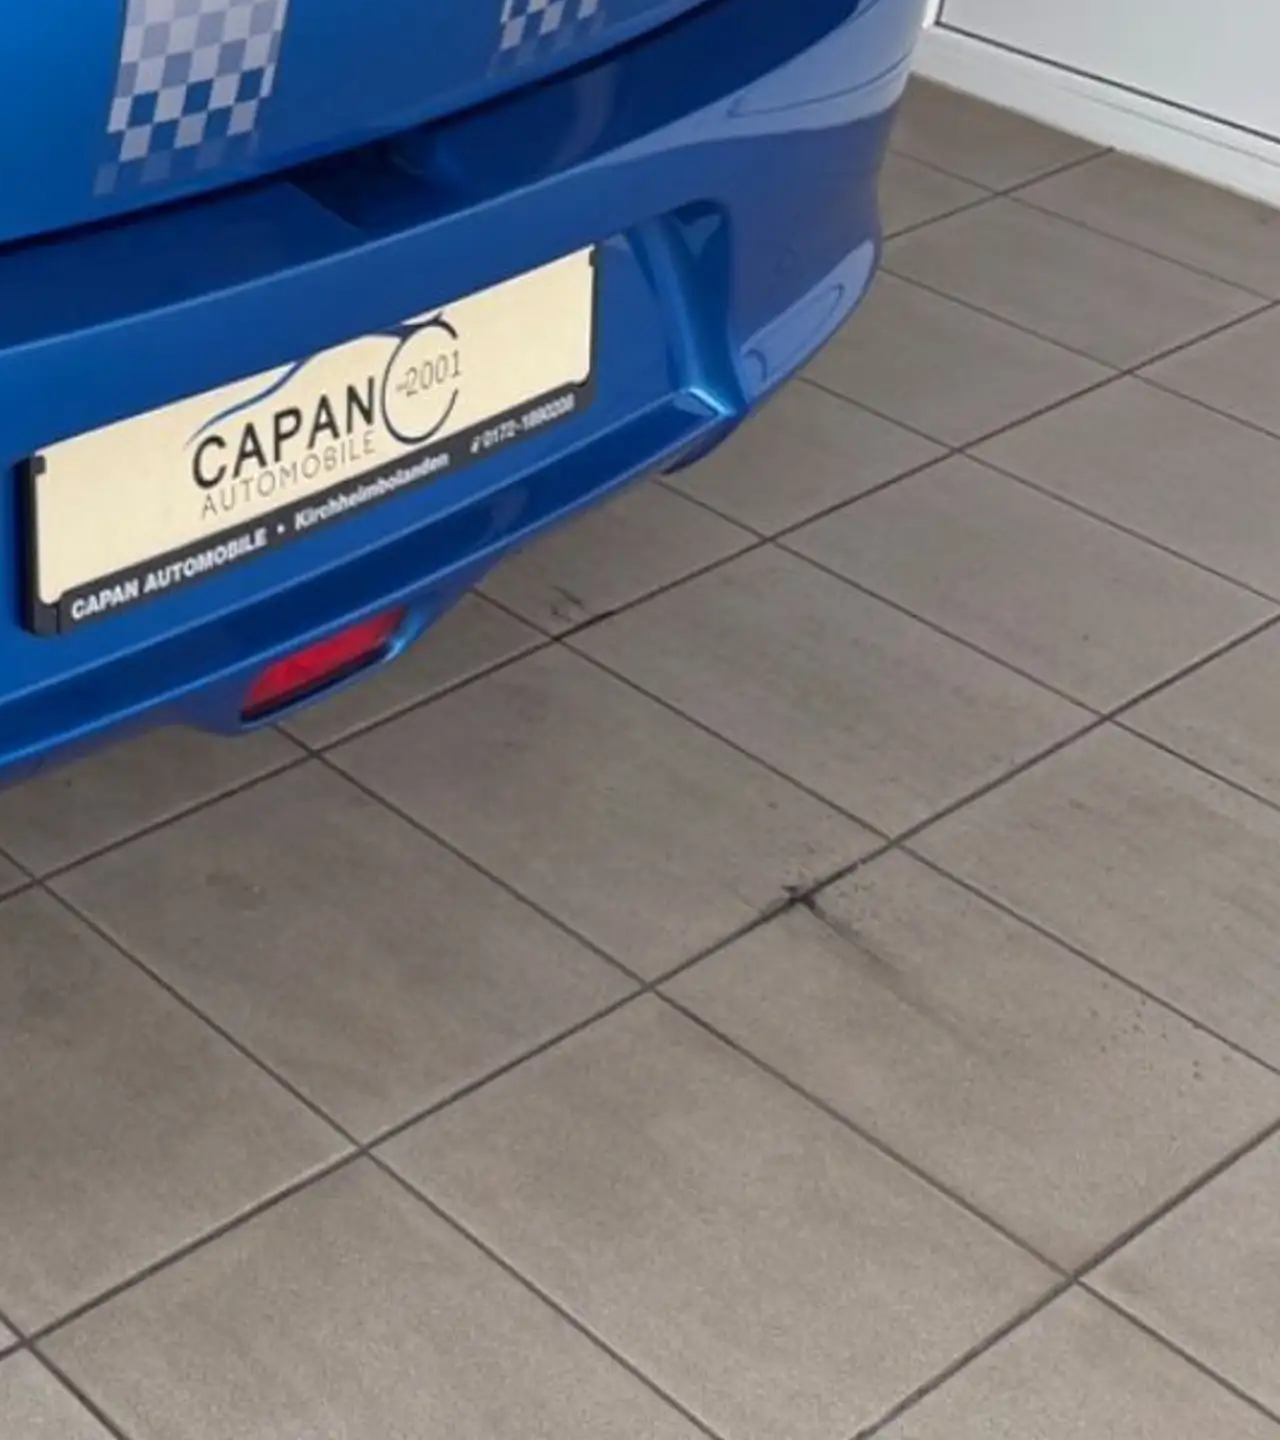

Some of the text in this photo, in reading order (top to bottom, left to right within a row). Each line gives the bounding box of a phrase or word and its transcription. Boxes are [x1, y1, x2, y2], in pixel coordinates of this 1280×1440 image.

[193, 376, 375, 489] CAPAN
[200, 430, 376, 520] AUTOMOBILE
[70, 578, 139, 620] CAPAN
[143, 527, 268, 594] AUTOMOBILE
